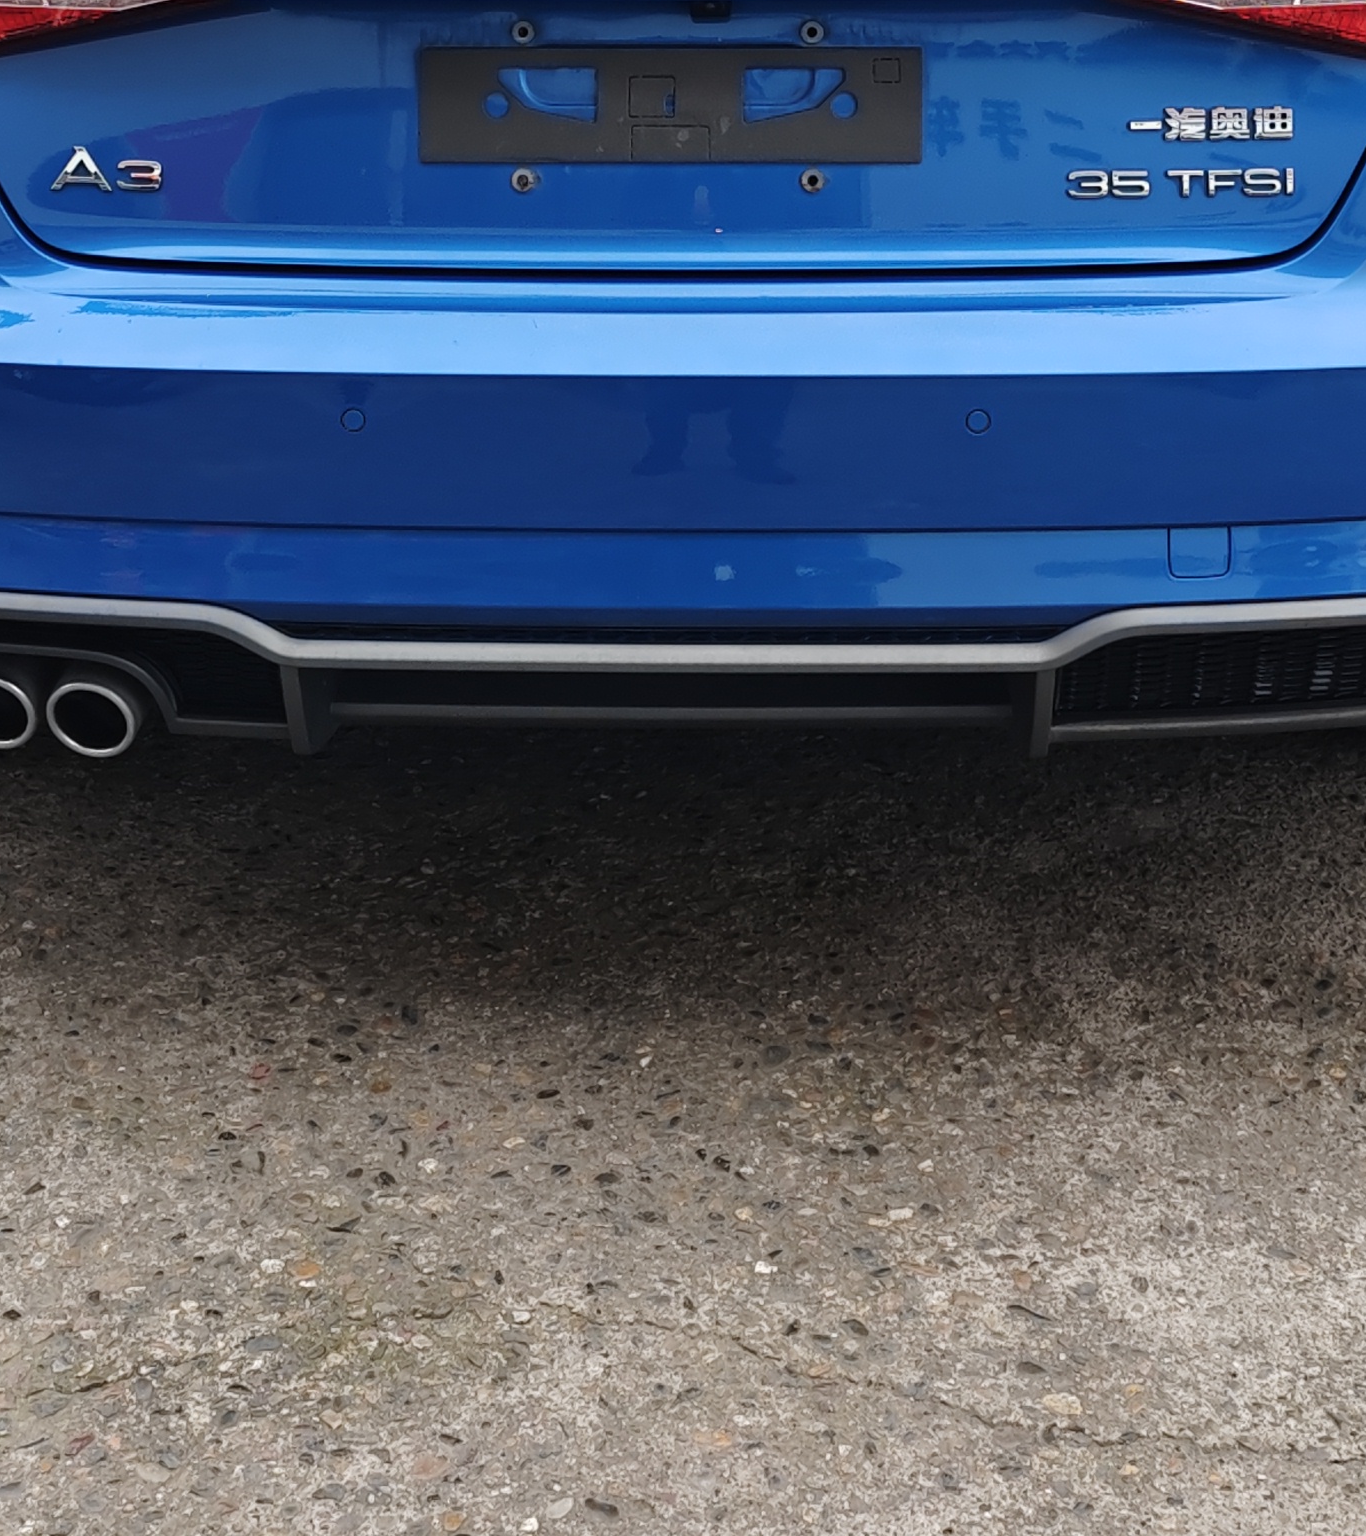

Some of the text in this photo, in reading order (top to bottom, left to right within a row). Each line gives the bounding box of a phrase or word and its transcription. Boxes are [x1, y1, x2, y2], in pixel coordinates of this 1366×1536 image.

[1129, 106, 1294, 141] 一汽奥迪
[50, 146, 162, 192] A3
[1067, 167, 1295, 198] 35 TFSI
